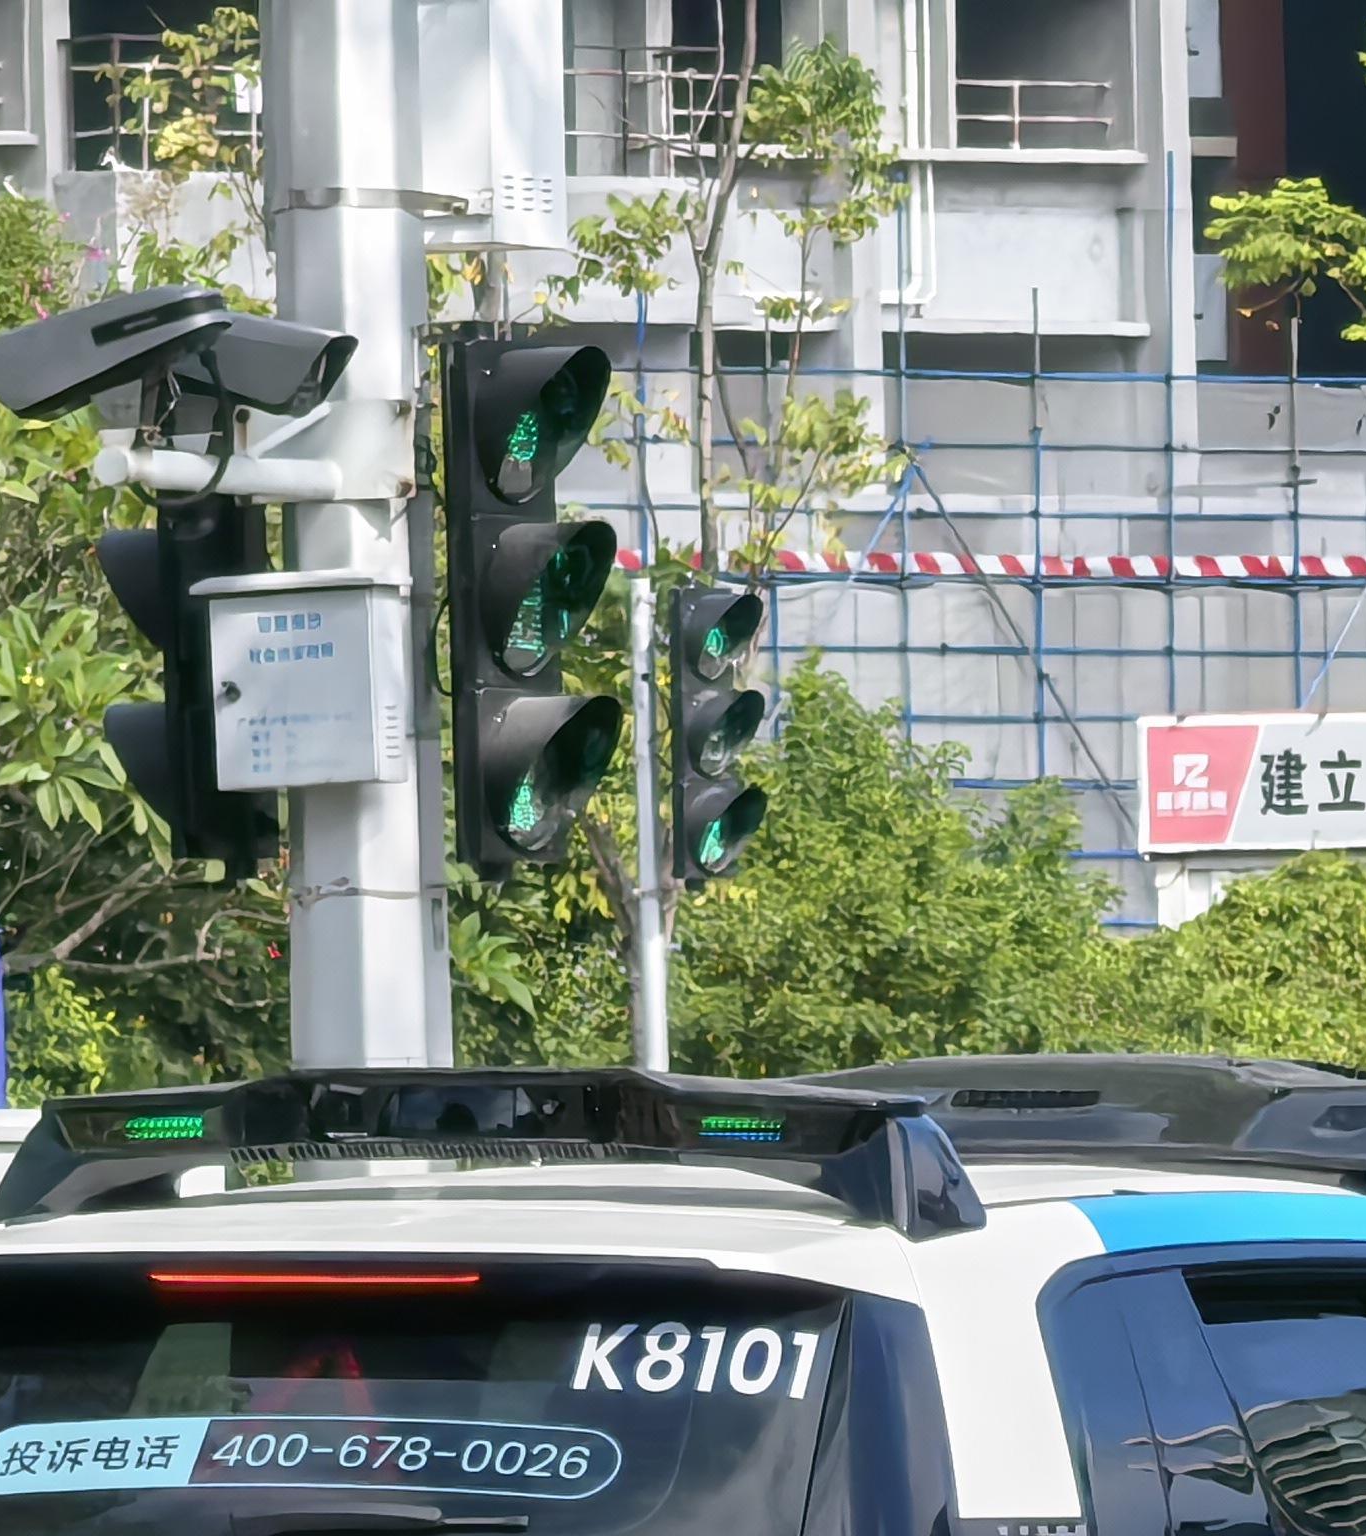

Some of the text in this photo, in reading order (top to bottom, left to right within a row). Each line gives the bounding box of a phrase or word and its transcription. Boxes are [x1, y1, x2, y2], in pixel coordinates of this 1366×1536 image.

[570, 1321, 819, 1400] K8101
[0, 1432, 591, 1480] 投诉电话 400-678-0026
